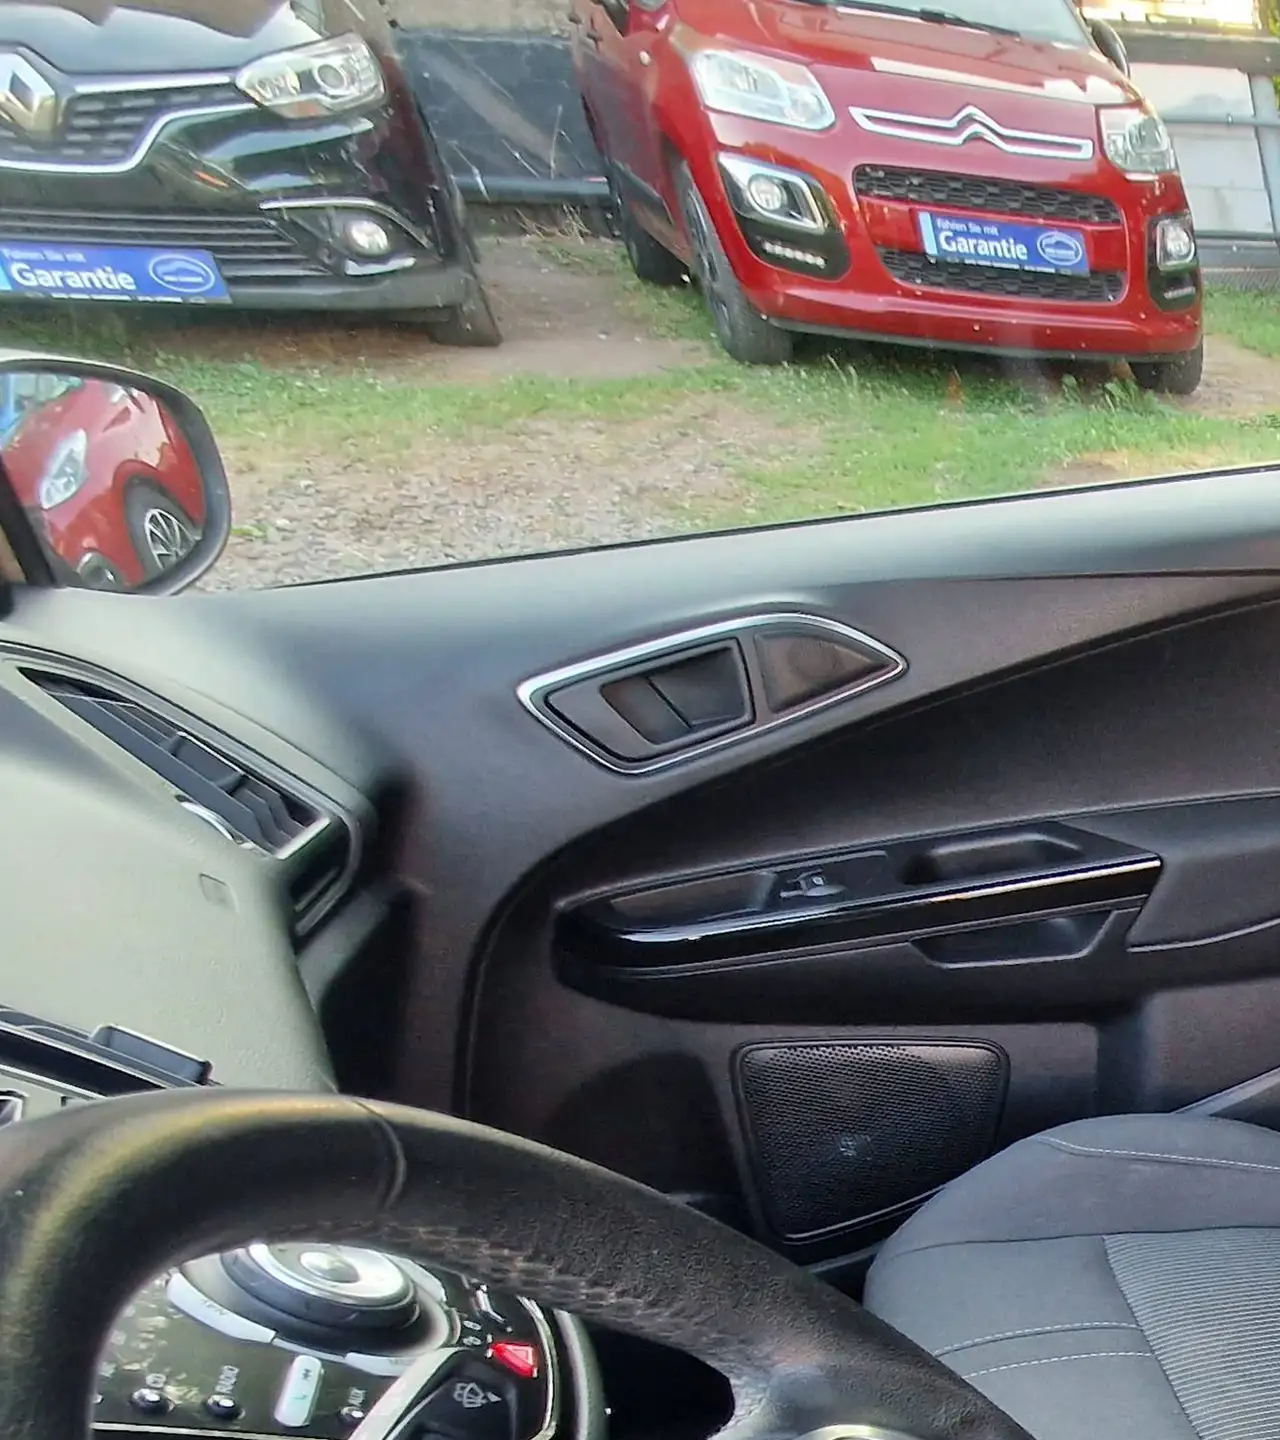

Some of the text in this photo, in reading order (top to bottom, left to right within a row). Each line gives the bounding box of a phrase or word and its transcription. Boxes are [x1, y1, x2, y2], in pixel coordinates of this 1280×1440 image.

[938, 231, 1028, 261] Garantie
[10, 262, 137, 290] Garantie
[215, 1364, 240, 1394] RADIO
